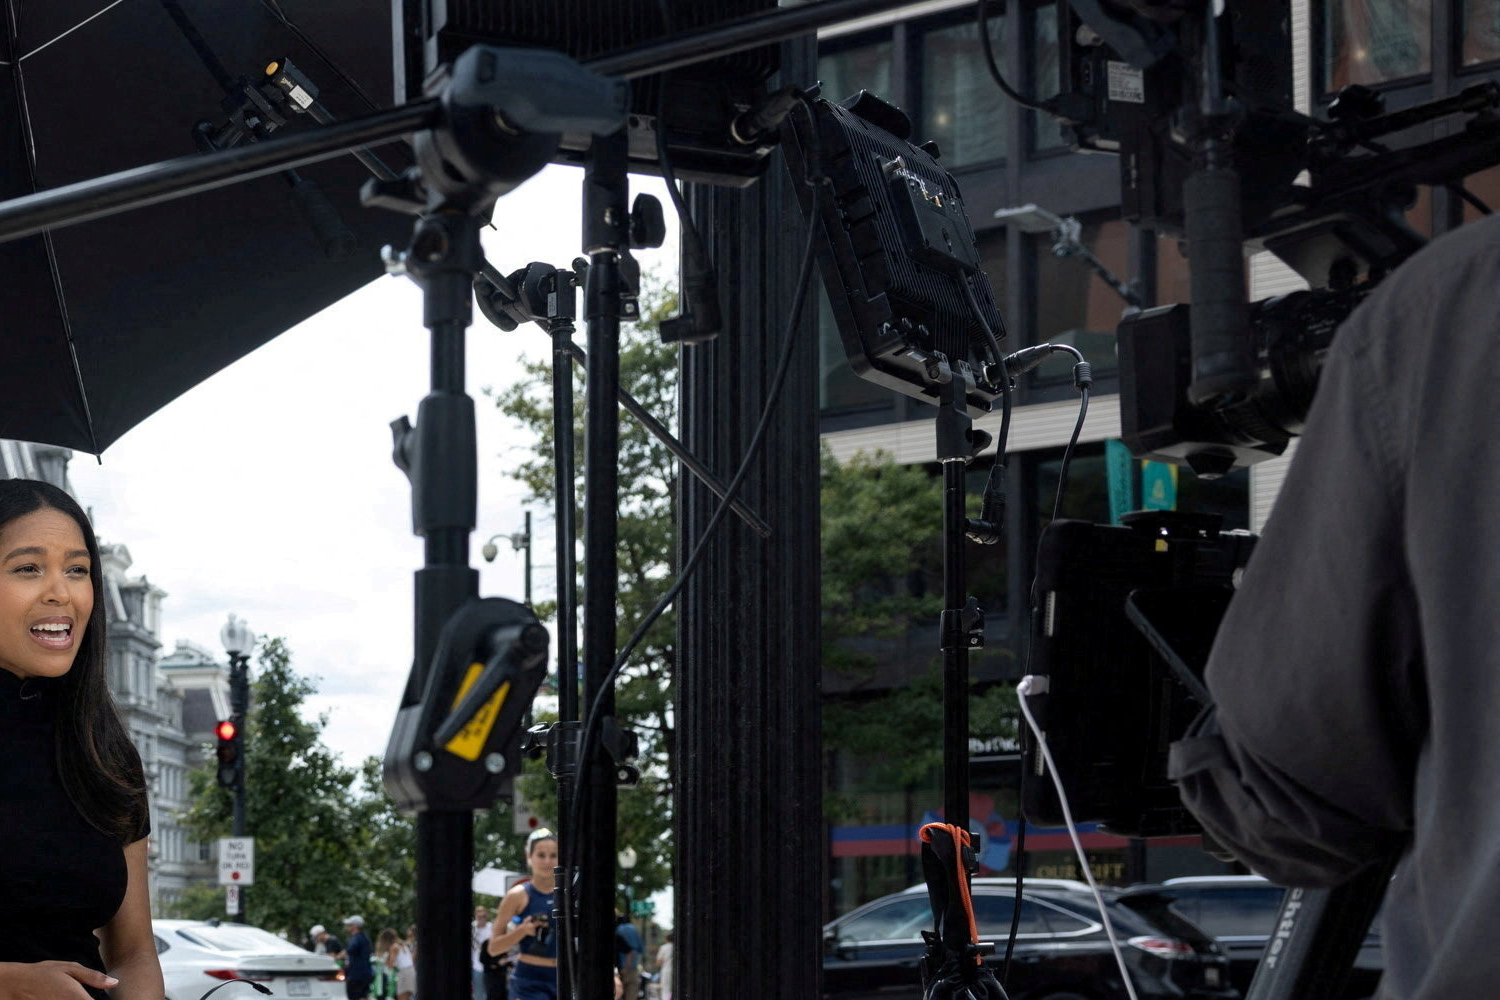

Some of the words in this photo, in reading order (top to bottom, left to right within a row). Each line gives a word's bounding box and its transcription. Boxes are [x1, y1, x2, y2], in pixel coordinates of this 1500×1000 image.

[228, 842, 244, 851] NO
[221, 862, 233, 870] ON
[236, 861, 250, 869] RED
[1036, 864, 1077, 879] OUR
[1266, 887, 1304, 970] chtler
